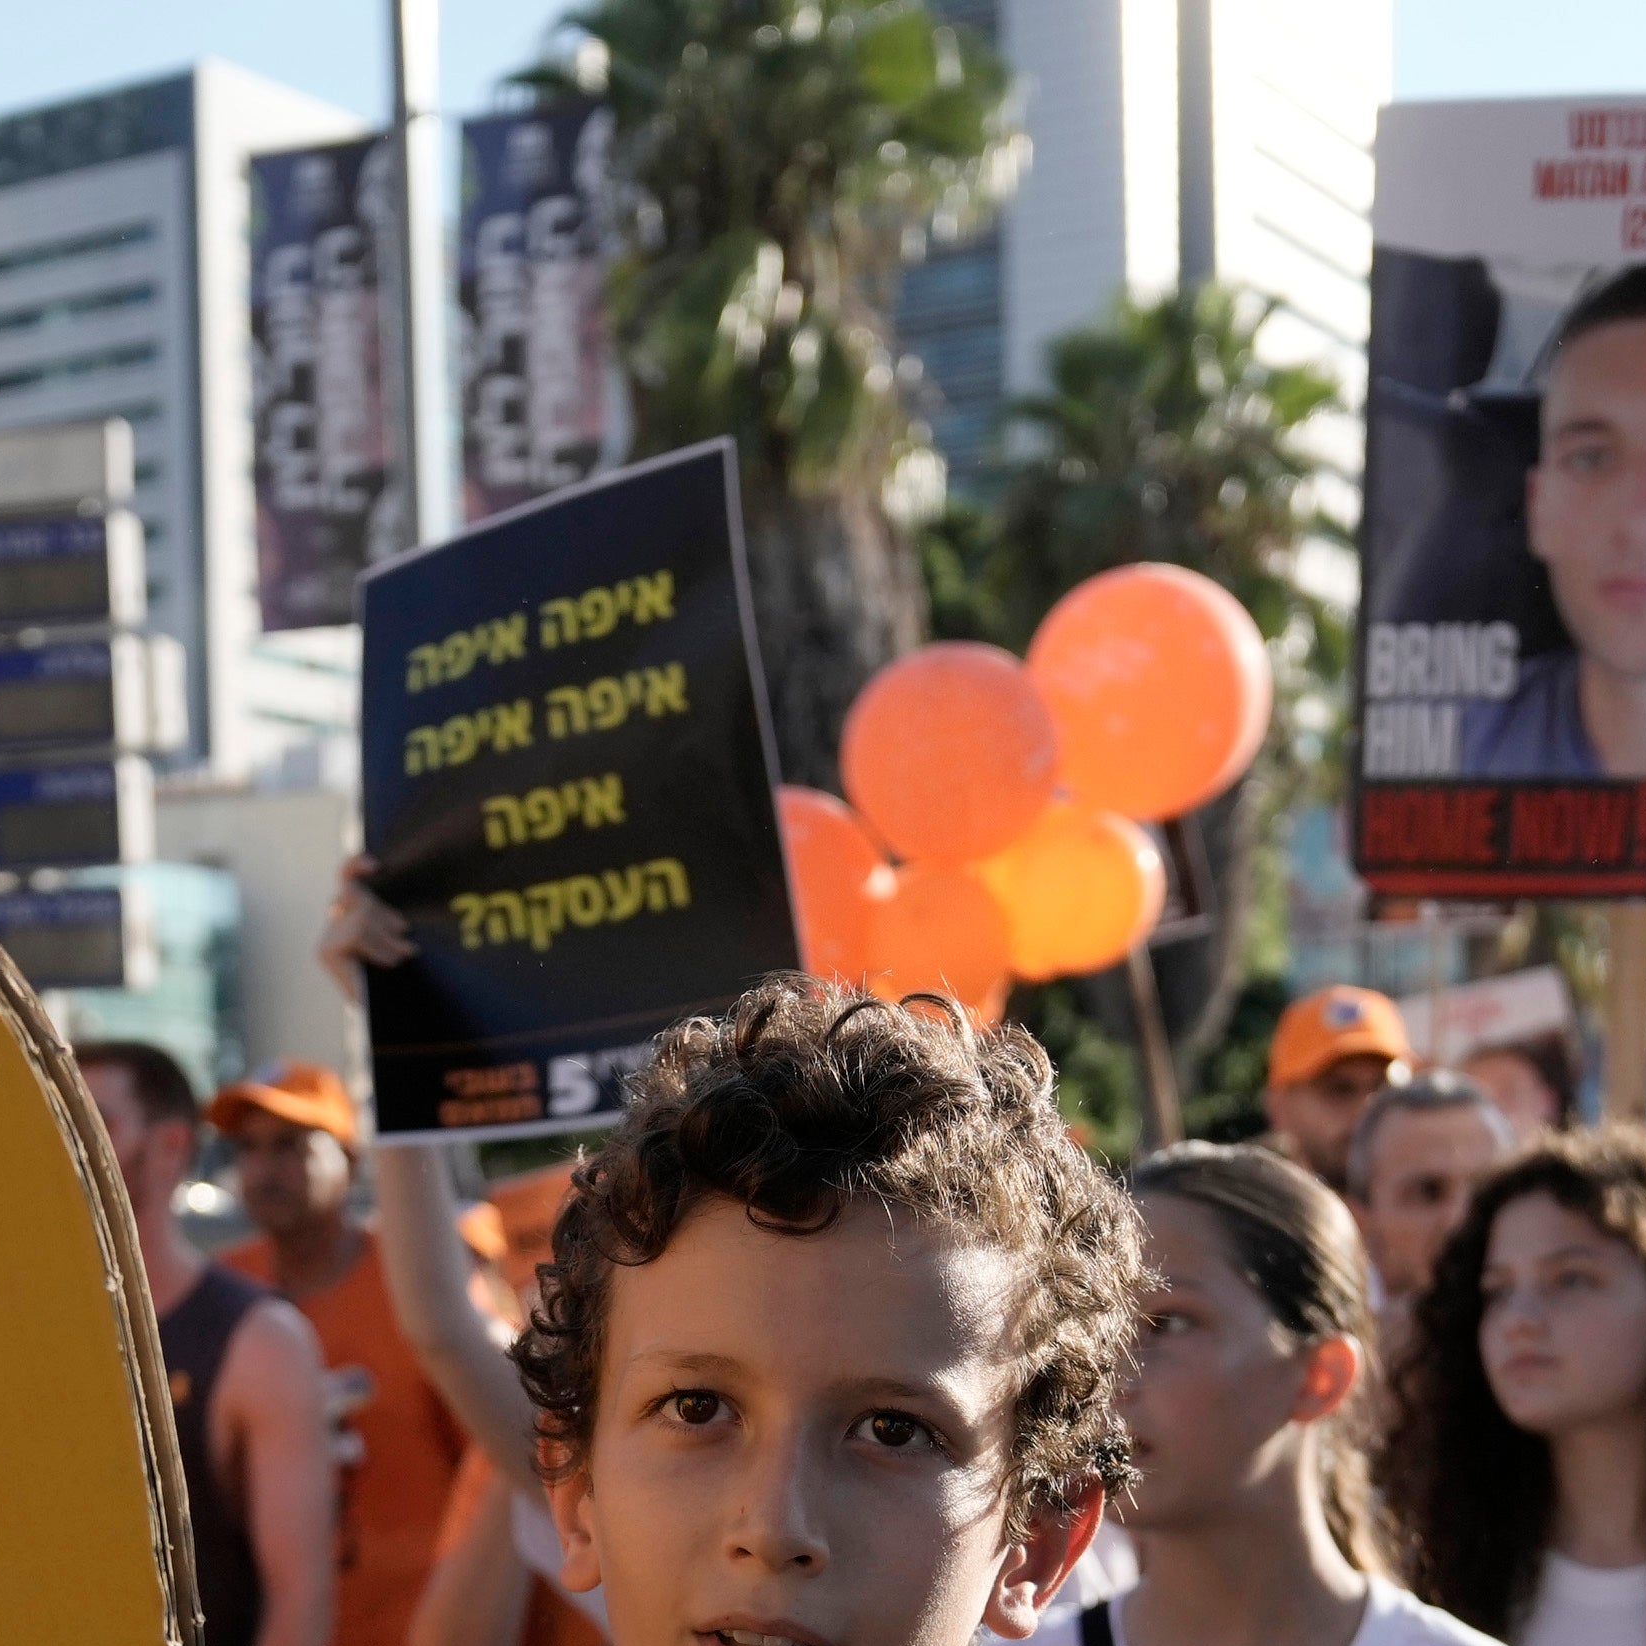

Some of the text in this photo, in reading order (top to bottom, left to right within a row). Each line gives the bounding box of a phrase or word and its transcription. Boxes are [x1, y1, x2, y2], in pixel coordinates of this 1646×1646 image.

[405, 569, 677, 694] איפה איפה
[1365, 620, 1521, 701] BRING
[404, 660, 689, 777] איפה איפה
[1363, 702, 1460, 777] HIM
[483, 773, 626, 850] איפה
[1363, 787, 1498, 862] HOME
[450, 856, 692, 951] העסקה?
[547, 1053, 599, 1117] 5
